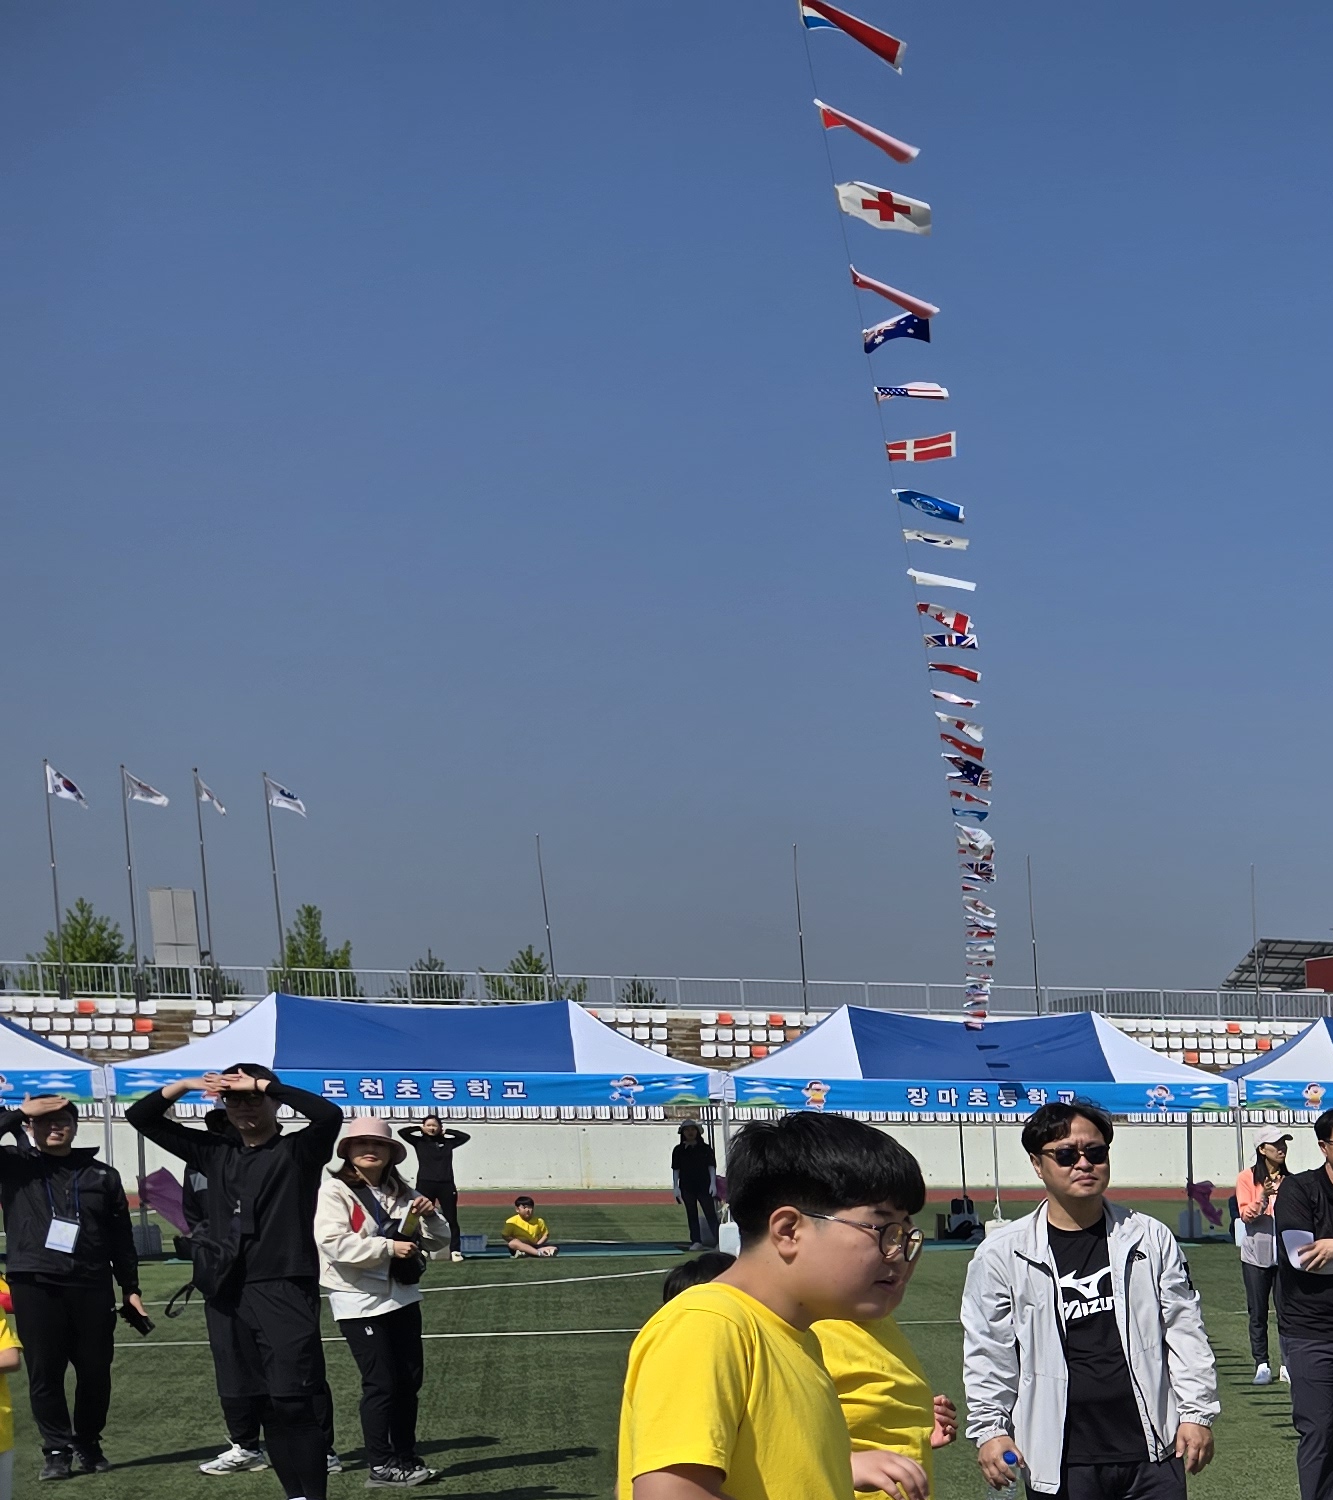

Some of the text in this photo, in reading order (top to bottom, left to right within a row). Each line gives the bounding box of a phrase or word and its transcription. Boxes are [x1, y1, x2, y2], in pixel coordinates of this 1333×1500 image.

[322, 1078, 528, 1100] 도천초등학교
[906, 1087, 1077, 1107] 장마초등학교
[1062, 1296, 1114, 1321] MIZU
